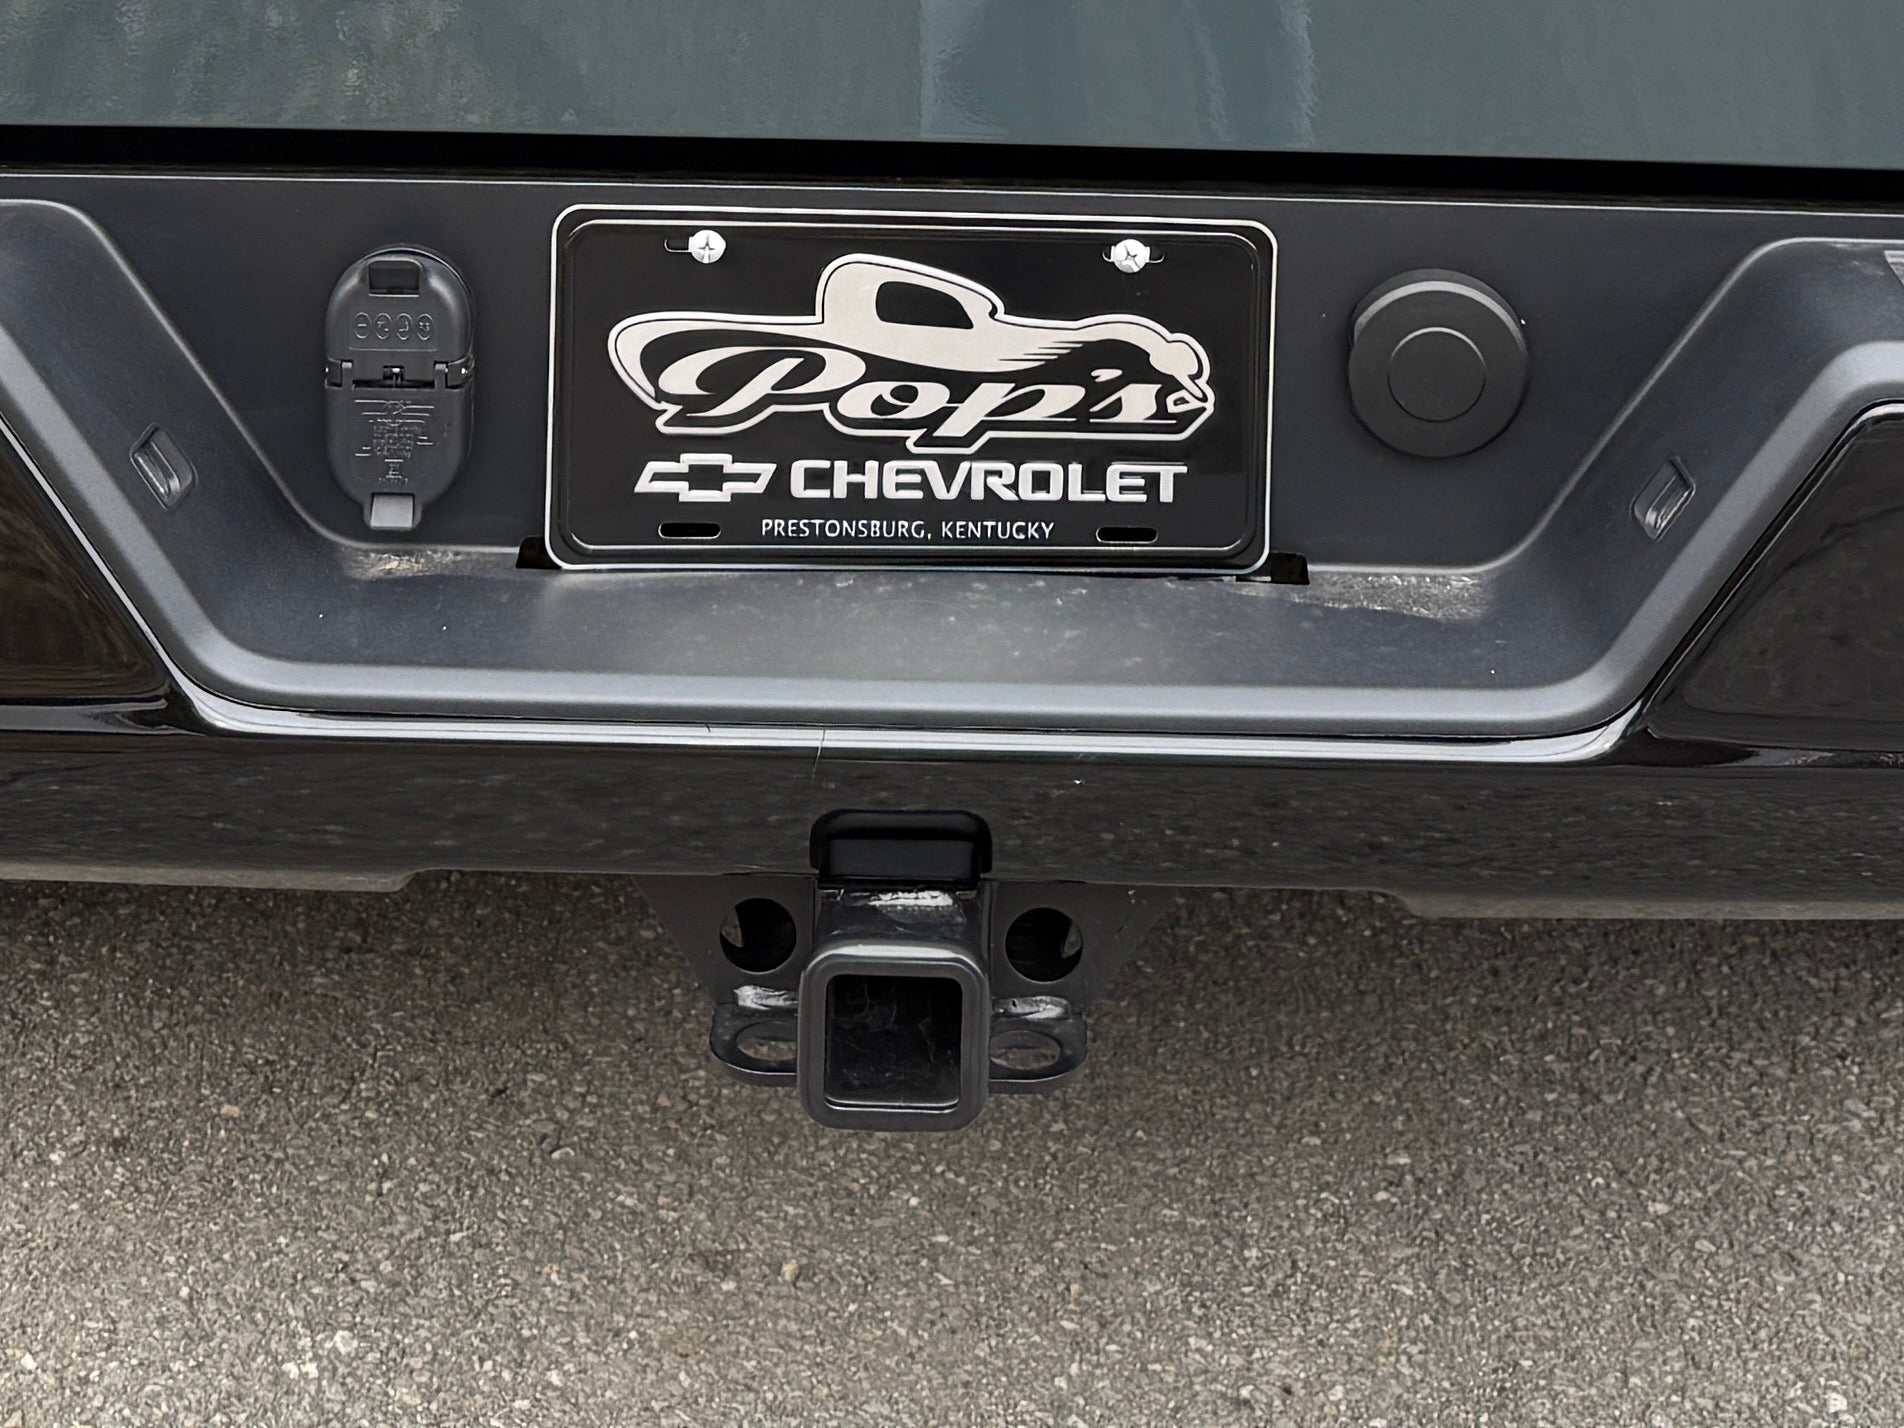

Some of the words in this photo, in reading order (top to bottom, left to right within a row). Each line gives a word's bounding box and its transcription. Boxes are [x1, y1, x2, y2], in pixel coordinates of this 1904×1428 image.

[656, 344, 1180, 438] Pop's
[789, 459, 1189, 504] CHEVROLET
[761, 518, 932, 540] PRESTONSBURG,
[941, 520, 1055, 540] KENTUCKY
